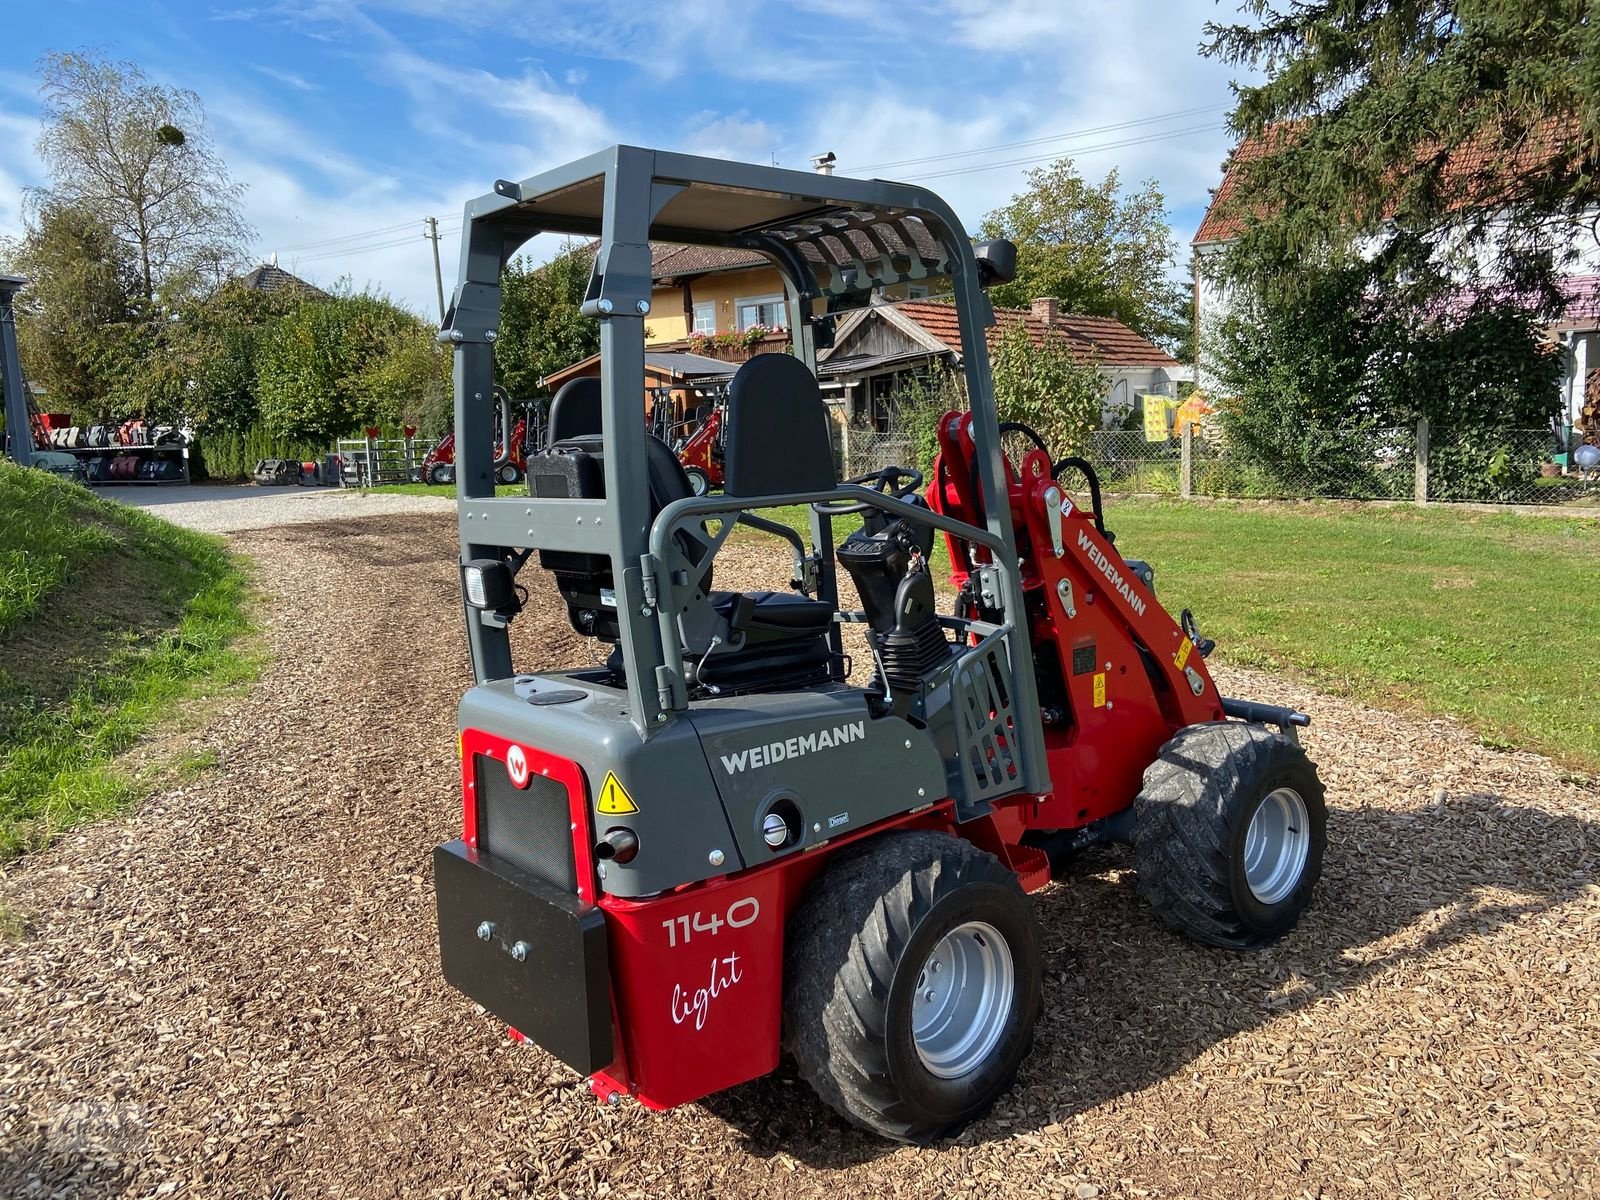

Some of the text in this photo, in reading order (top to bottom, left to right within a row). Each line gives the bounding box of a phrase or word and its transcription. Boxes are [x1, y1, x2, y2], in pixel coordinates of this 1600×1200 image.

[1077, 528, 1146, 616] WEIDEMANN
[720, 721, 865, 775] WEIDEMANN
[829, 813, 849, 827] Diesel
[662, 896, 760, 947] 1140
[672, 951, 743, 1031] light
